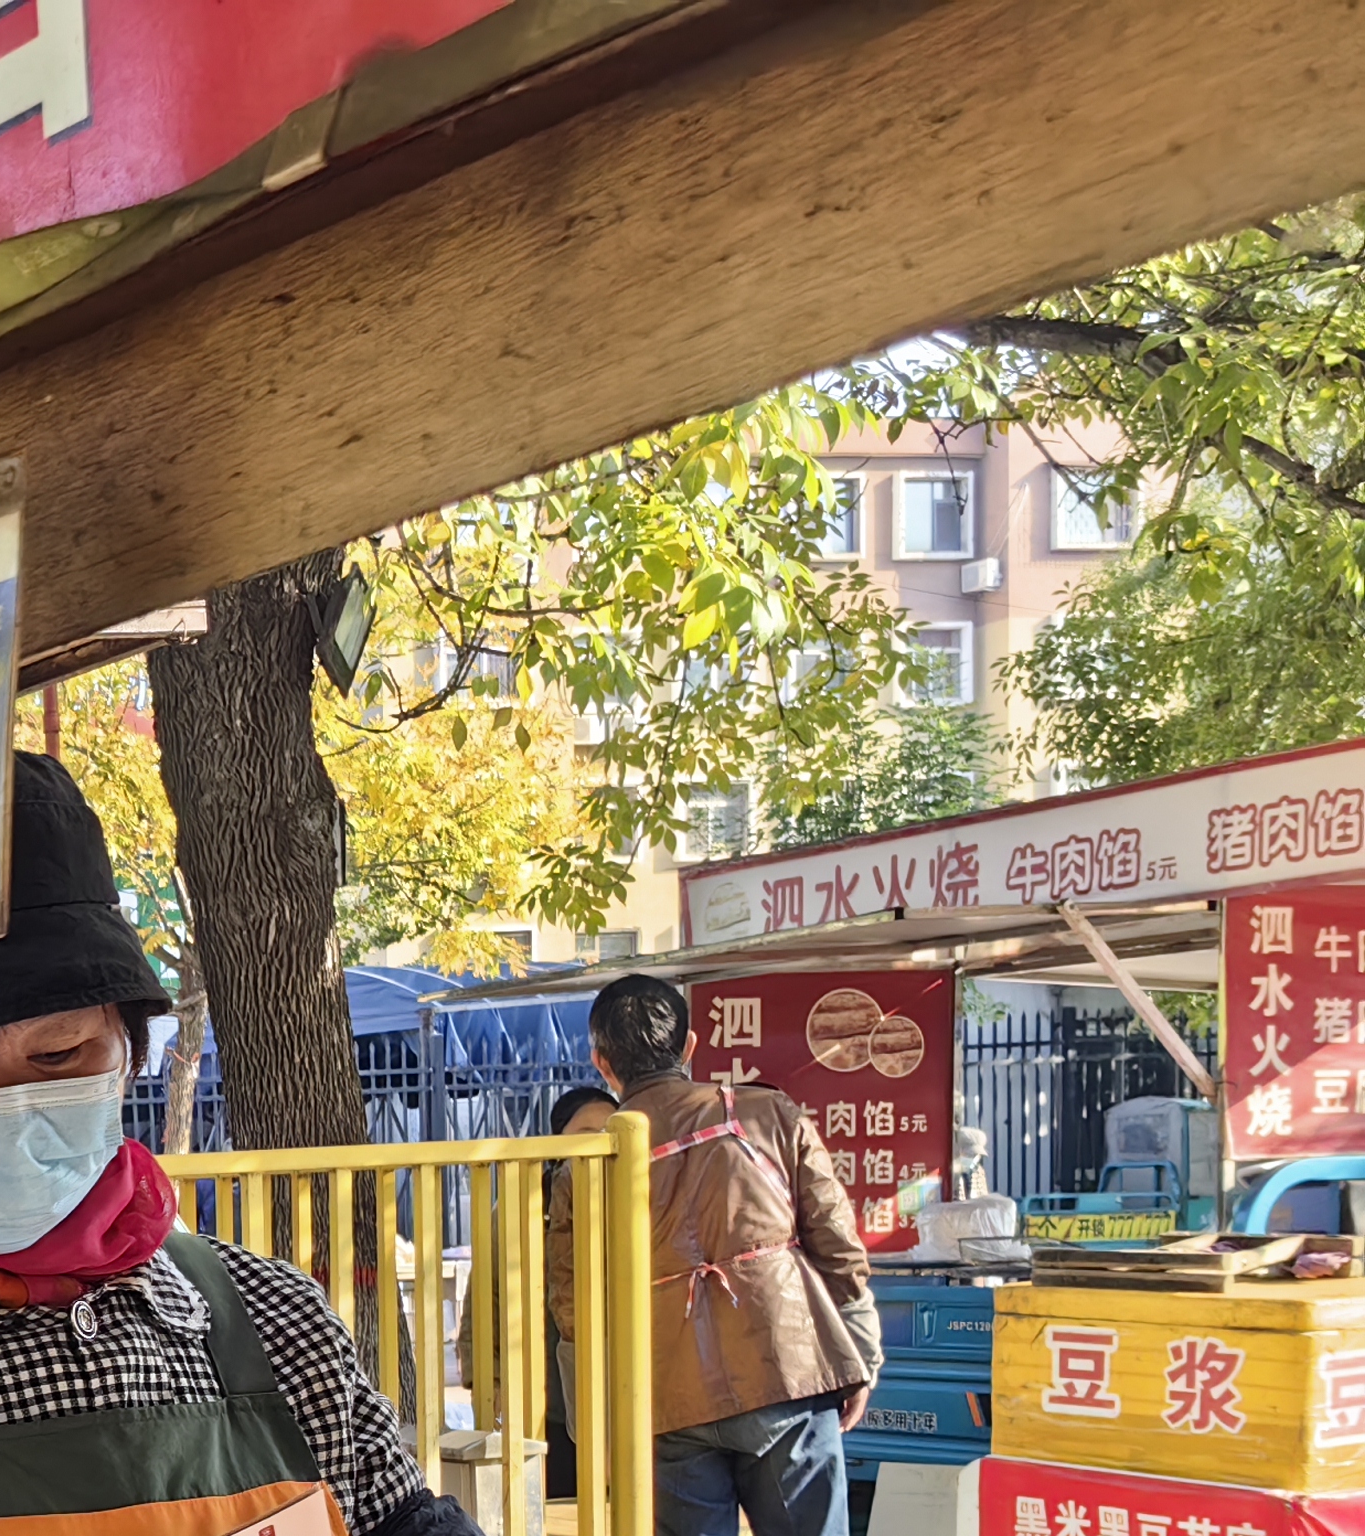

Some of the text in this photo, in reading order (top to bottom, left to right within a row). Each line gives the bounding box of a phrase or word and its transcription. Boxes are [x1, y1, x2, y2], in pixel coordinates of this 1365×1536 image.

[762, 788, 1365, 930] 泗水火烧 牛肉馅 5元 猪肉馅
[1314, 925, 1365, 974] 牛
[1245, 904, 1295, 1138] 泗水火烧
[1313, 997, 1365, 1044] 猪
[1311, 1069, 1365, 1114] 豆
[899, 1114, 928, 1132] 5元
[852, 1197, 895, 1234] 馅
[1041, 1325, 1247, 1434] 豆浆
